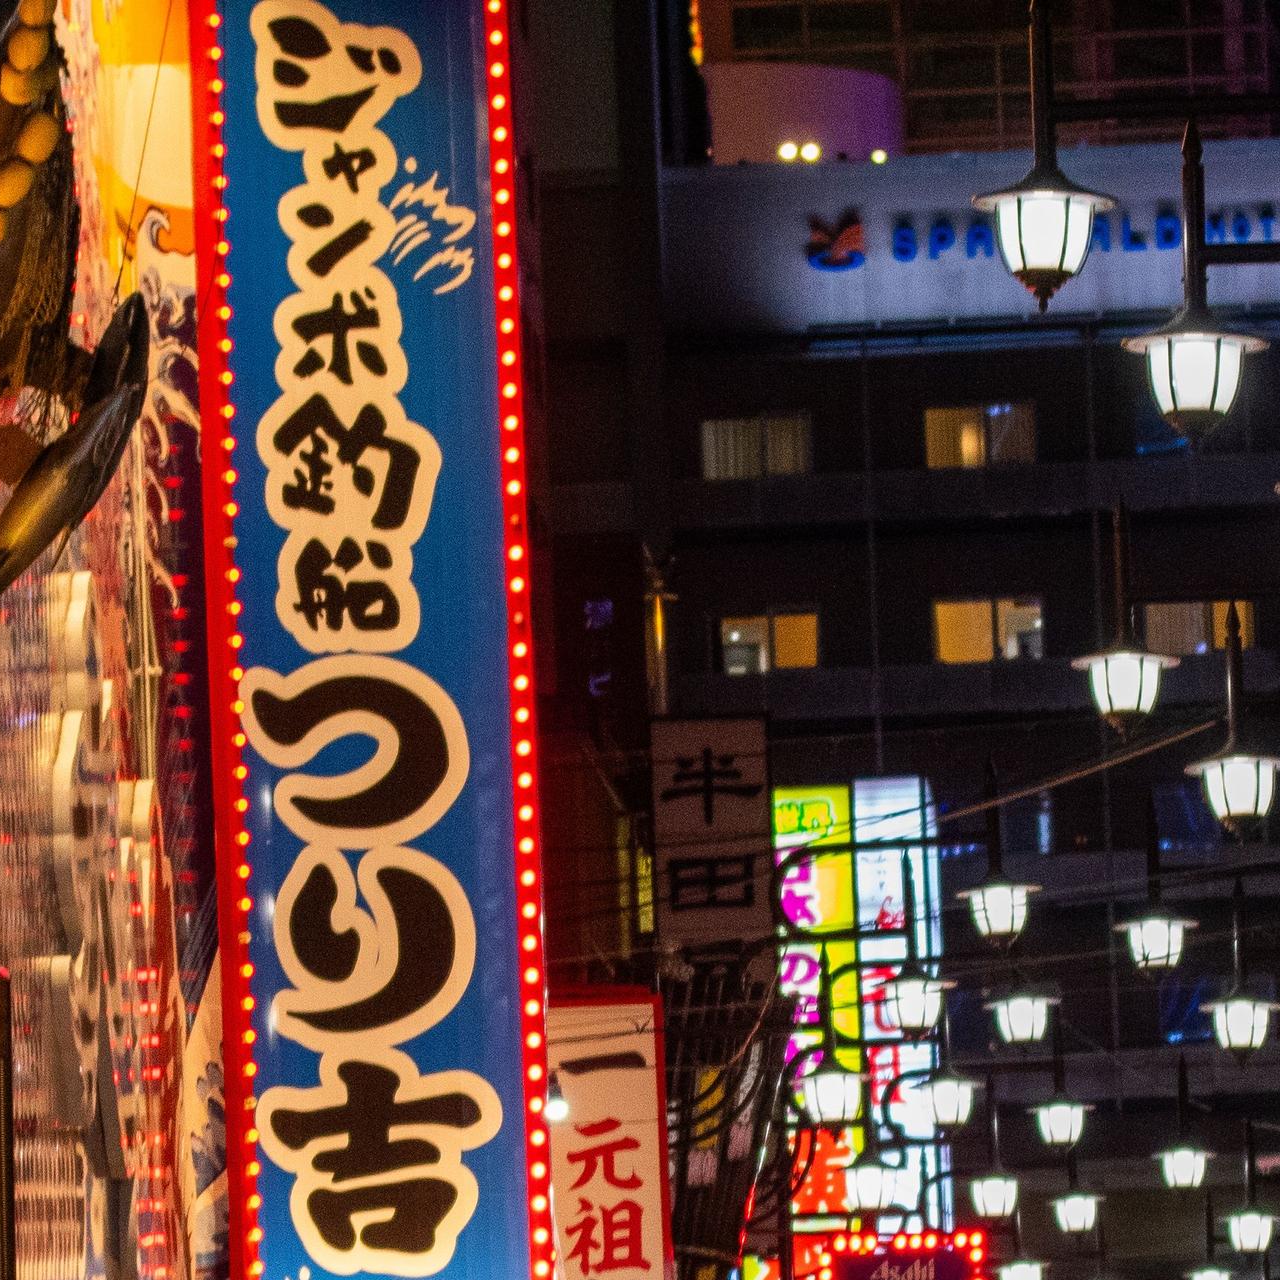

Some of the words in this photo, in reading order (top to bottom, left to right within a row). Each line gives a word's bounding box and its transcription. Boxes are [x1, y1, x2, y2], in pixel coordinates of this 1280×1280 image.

[267, 15, 421, 632] ジャンボ釣船
[253, 676, 482, 1253] つり吉
[565, 1118, 651, 1276] 元祖
